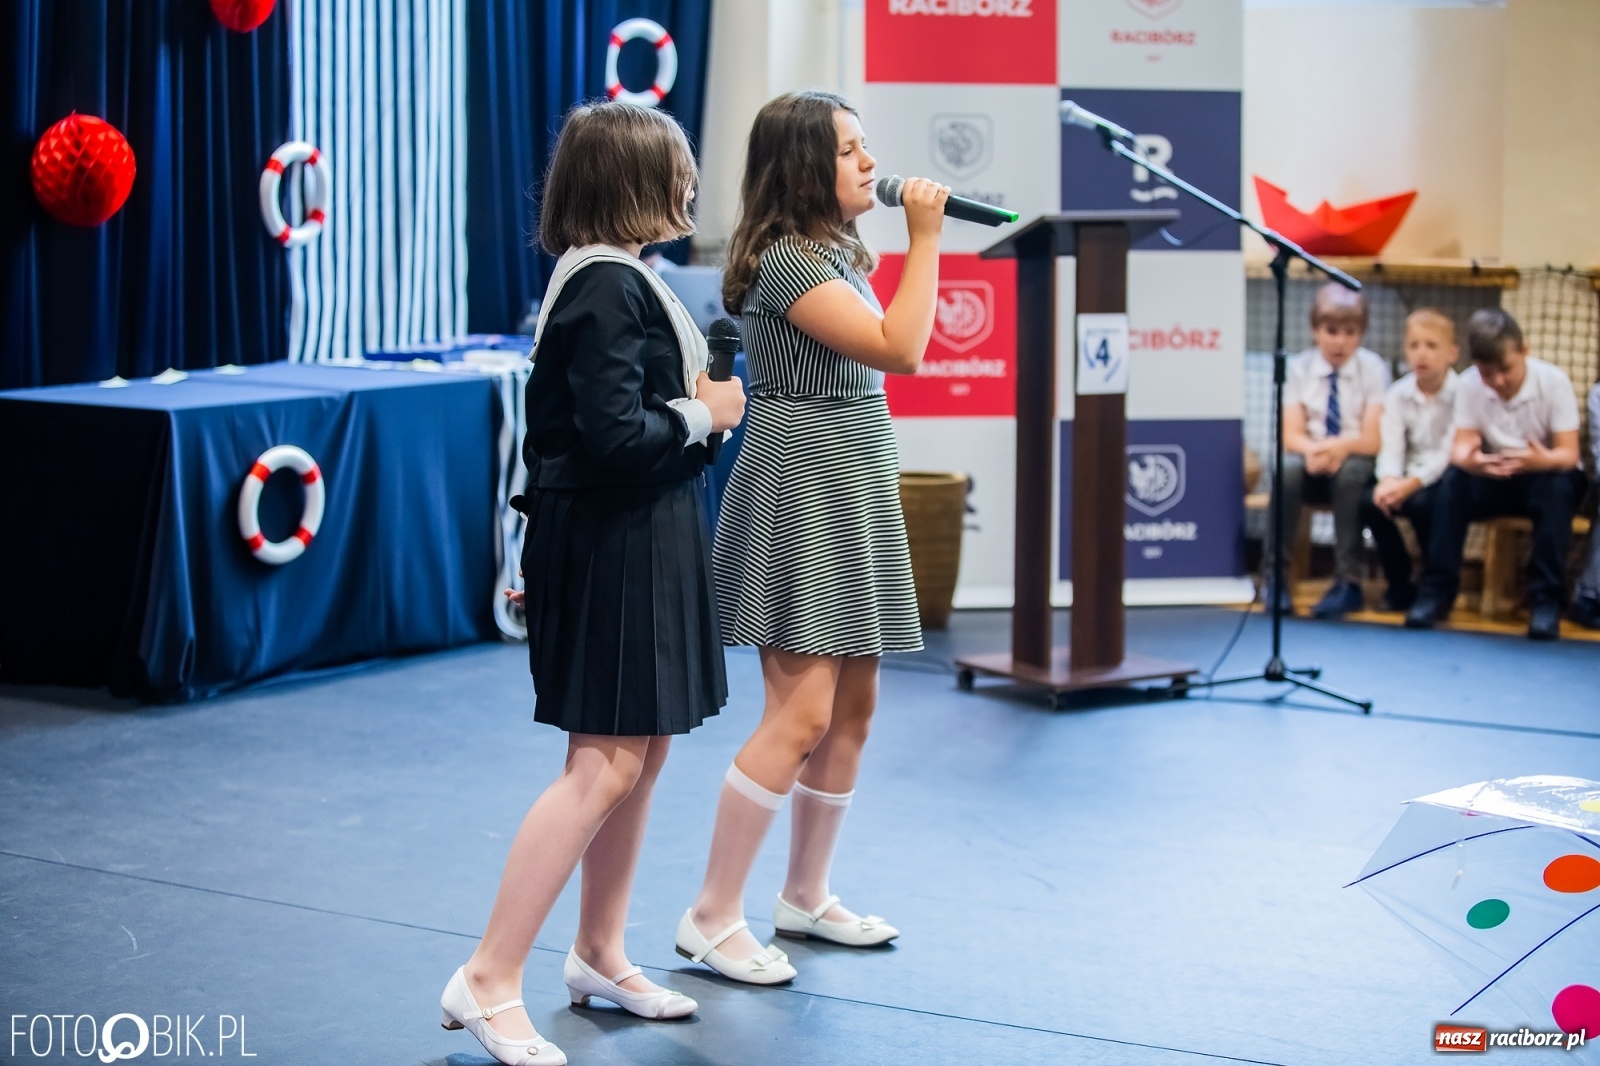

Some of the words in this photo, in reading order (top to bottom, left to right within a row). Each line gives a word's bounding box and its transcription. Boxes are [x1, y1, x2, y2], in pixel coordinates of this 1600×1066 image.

[1129, 324, 1222, 351] CIBÓRZ
[1096, 338, 1111, 366] 4
[1123, 518, 1198, 542] ACIBÓRZ
